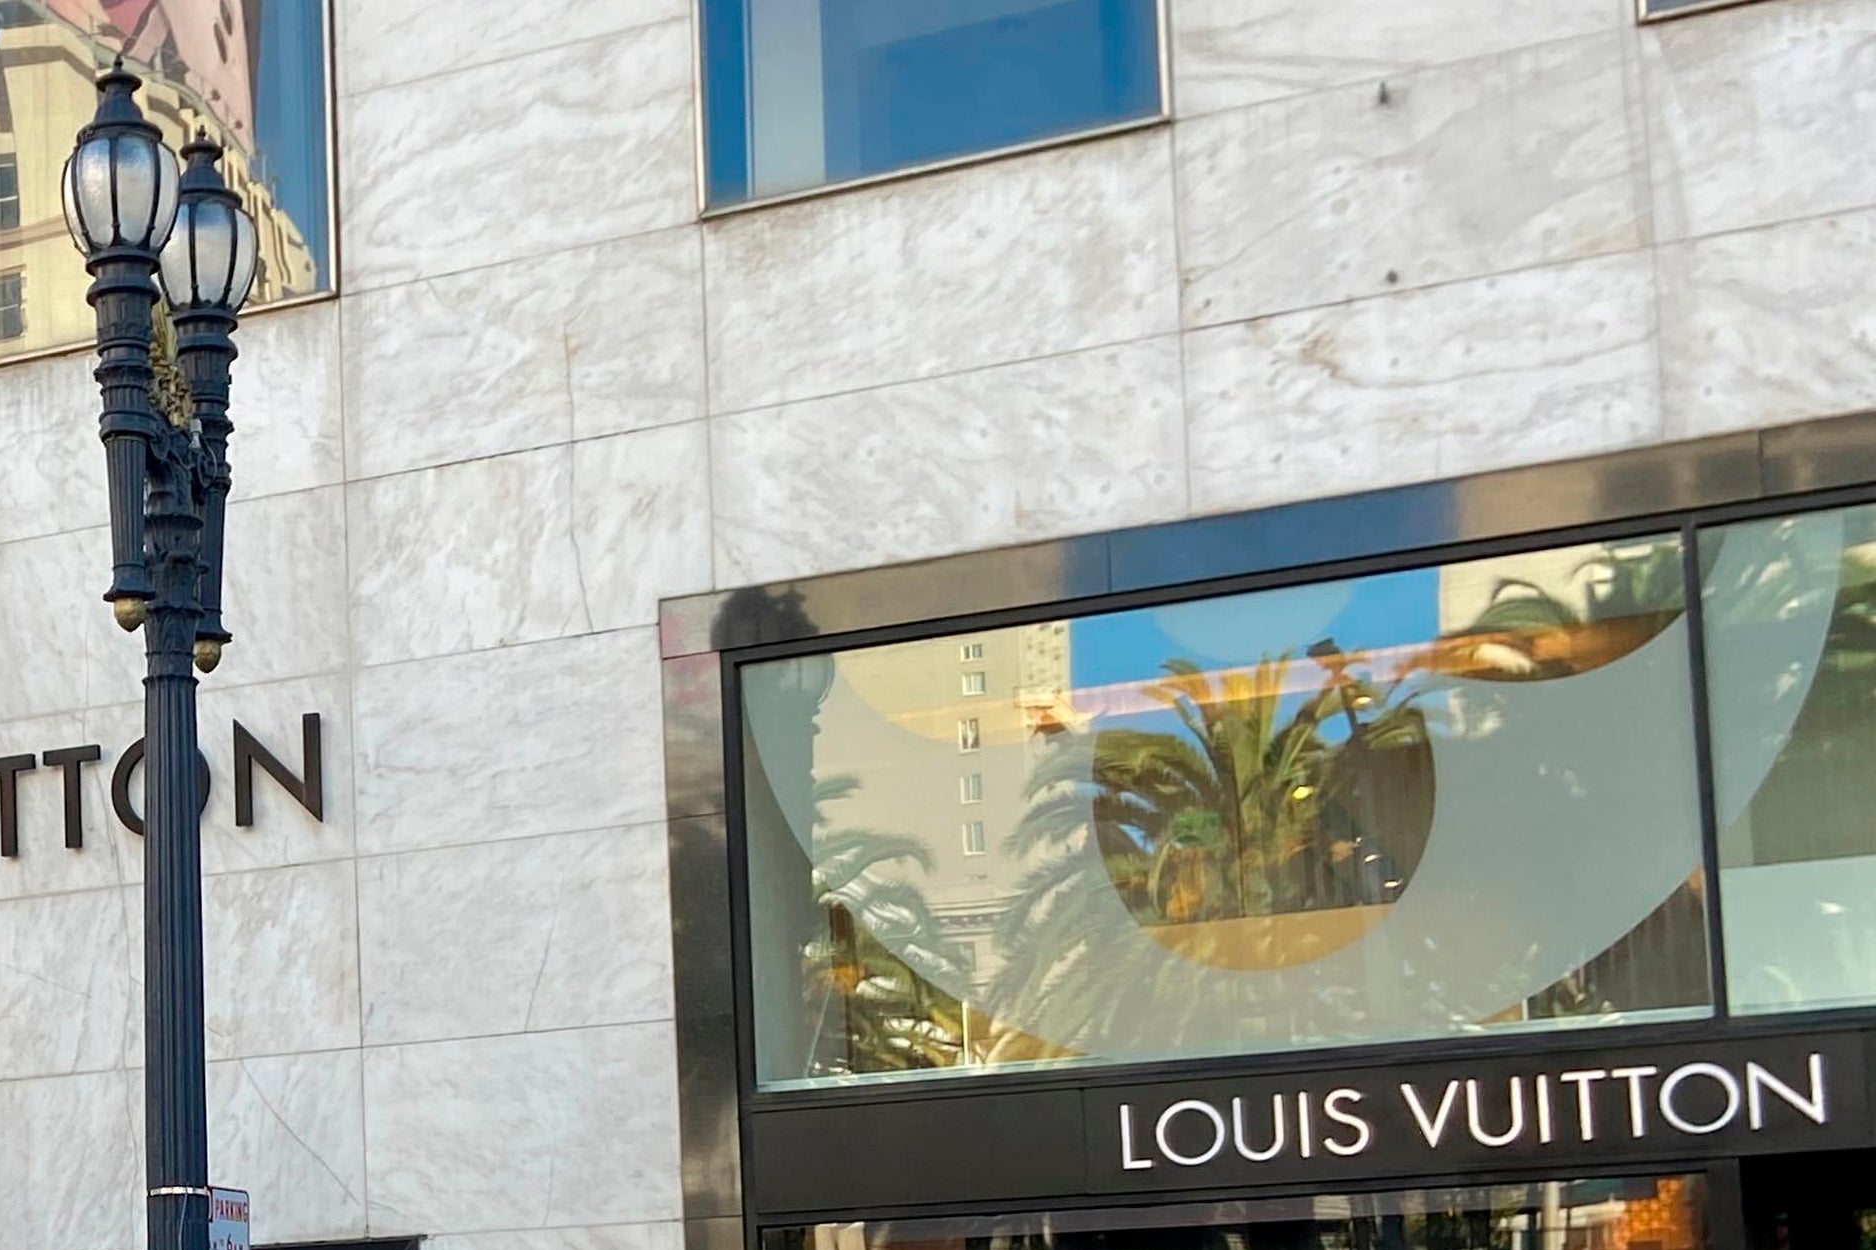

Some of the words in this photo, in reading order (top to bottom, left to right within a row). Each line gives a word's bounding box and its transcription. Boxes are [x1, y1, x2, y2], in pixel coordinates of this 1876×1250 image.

[1119, 1088, 1373, 1171] LOUIS
[1400, 1052, 1826, 1149] VUITTON
[215, 1199, 248, 1222] PARKING
